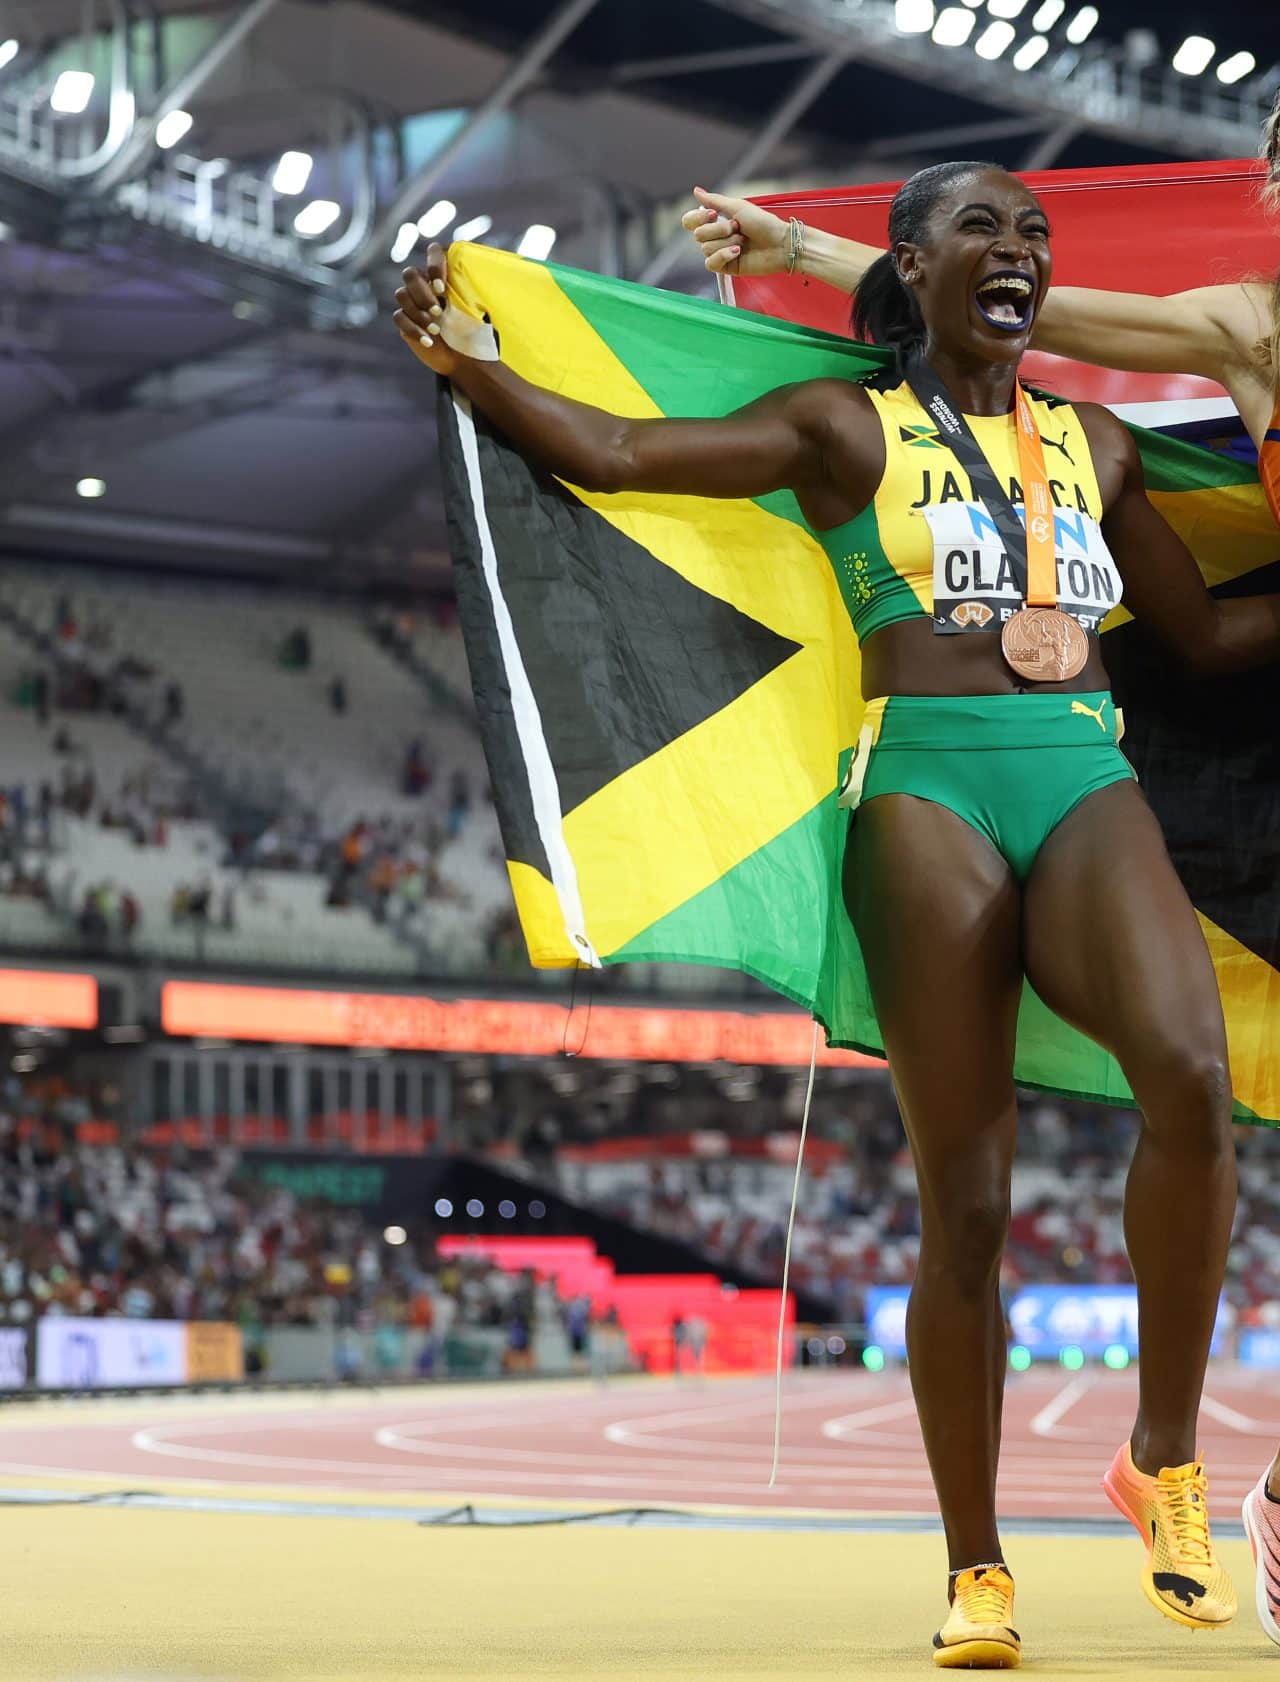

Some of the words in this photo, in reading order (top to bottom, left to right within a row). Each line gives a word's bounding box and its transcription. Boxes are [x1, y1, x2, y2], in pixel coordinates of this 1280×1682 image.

[929, 402, 956, 434] WITNESS
[932, 394, 960, 427] WONDER
[910, 470, 1098, 521] JAACA
[944, 548, 1115, 603] CLATON
